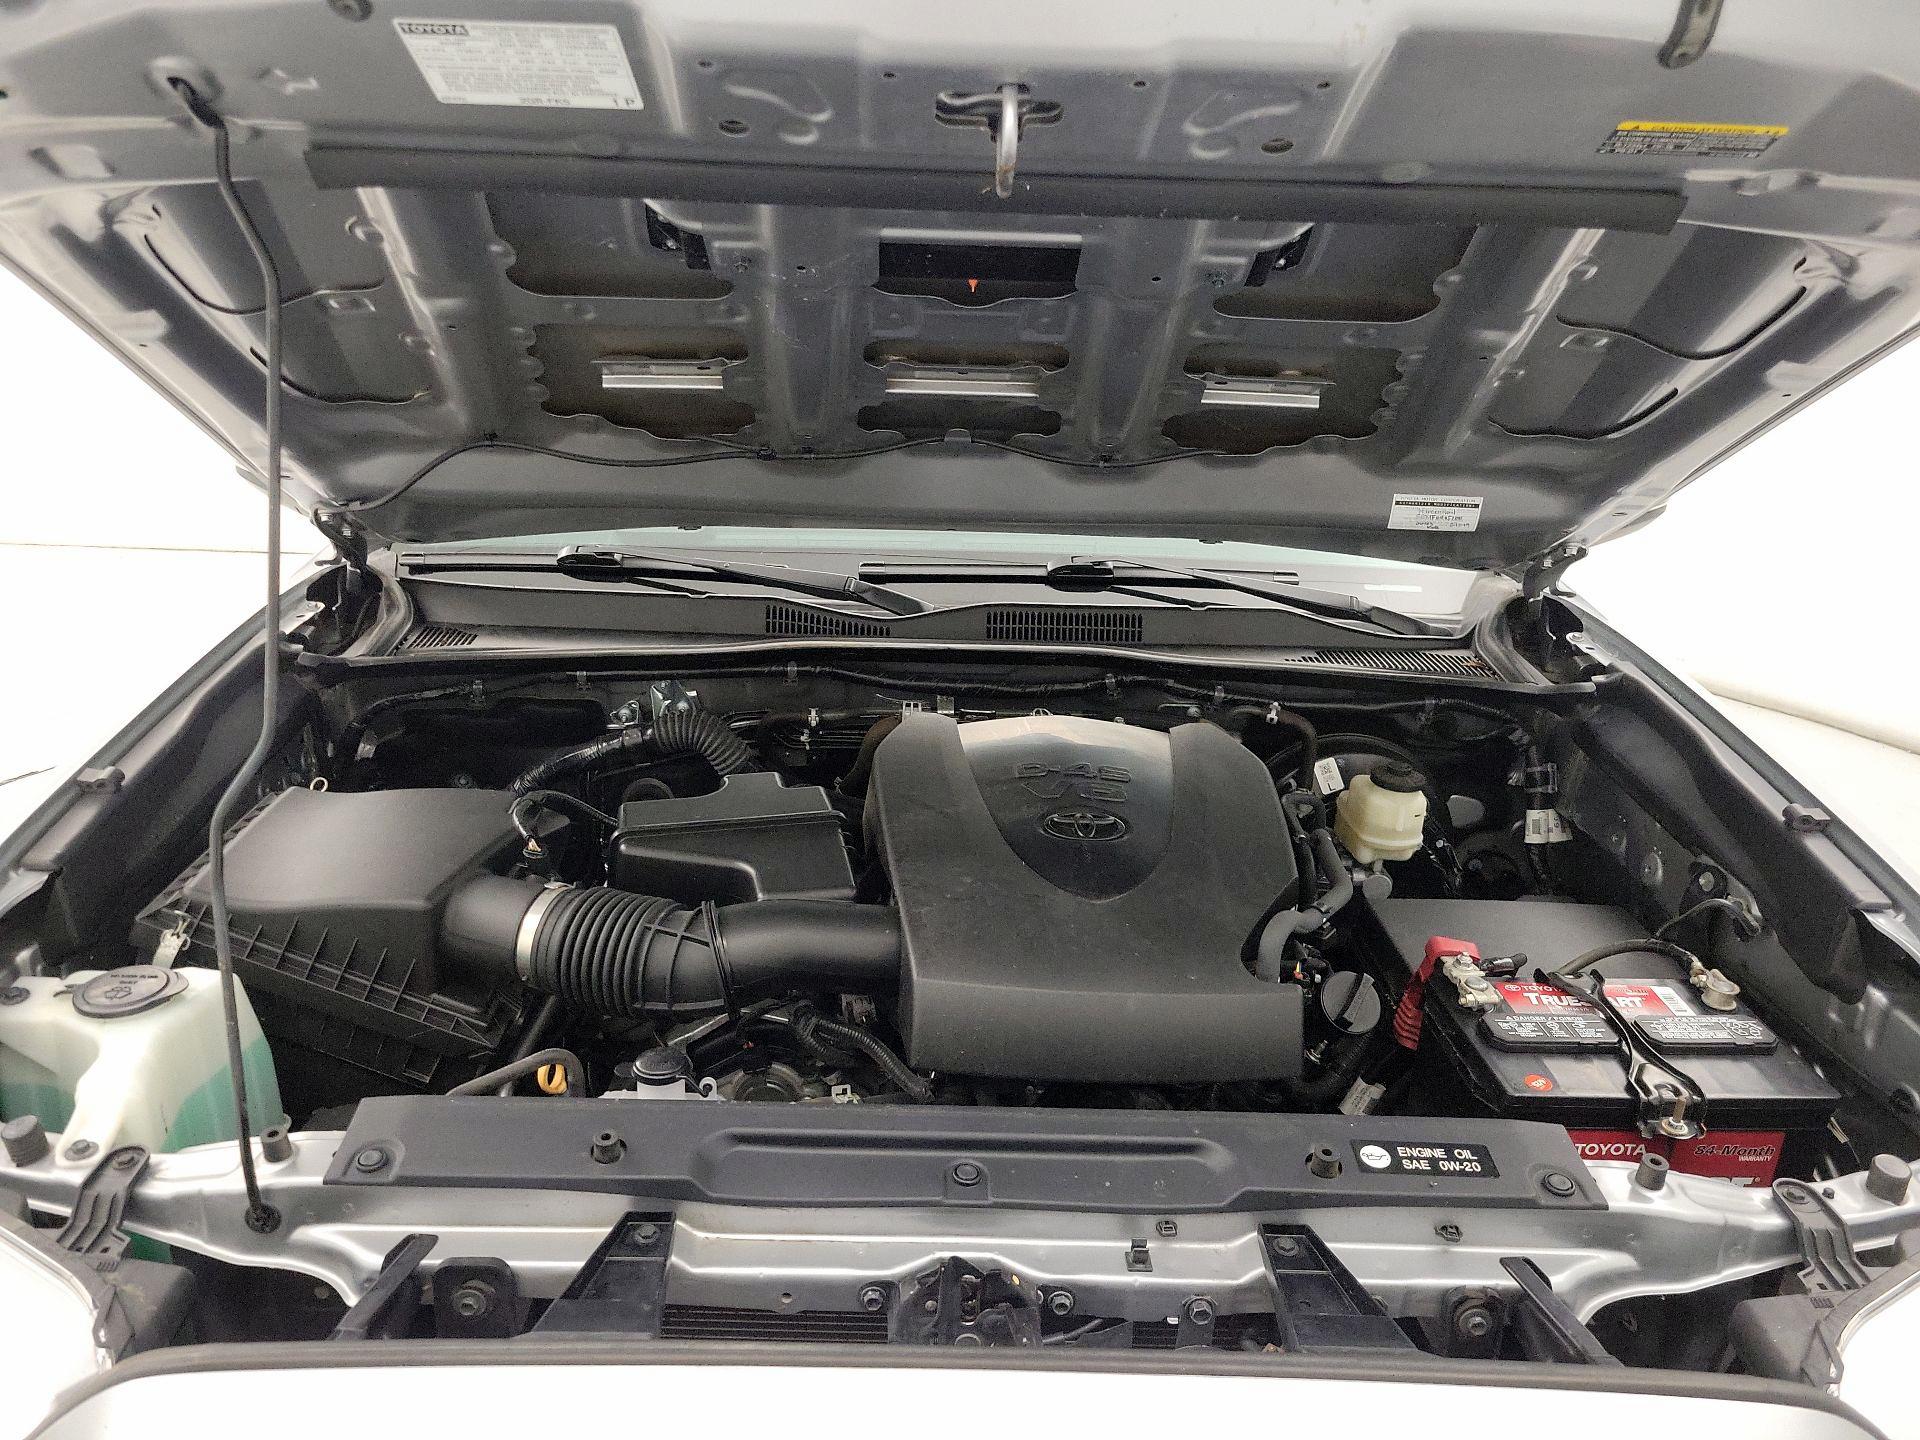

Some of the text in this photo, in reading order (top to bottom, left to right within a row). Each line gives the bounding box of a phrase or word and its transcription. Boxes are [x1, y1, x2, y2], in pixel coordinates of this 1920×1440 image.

[401, 23, 468, 35] TOYOTA
[1396, 1146, 1478, 1160] ENGINE OIL
[1575, 1143, 1647, 1156] TOYOTA
[1694, 1144, 1776, 1157] 84-Month
[1402, 1159, 1482, 1173] SAE 0W-20
